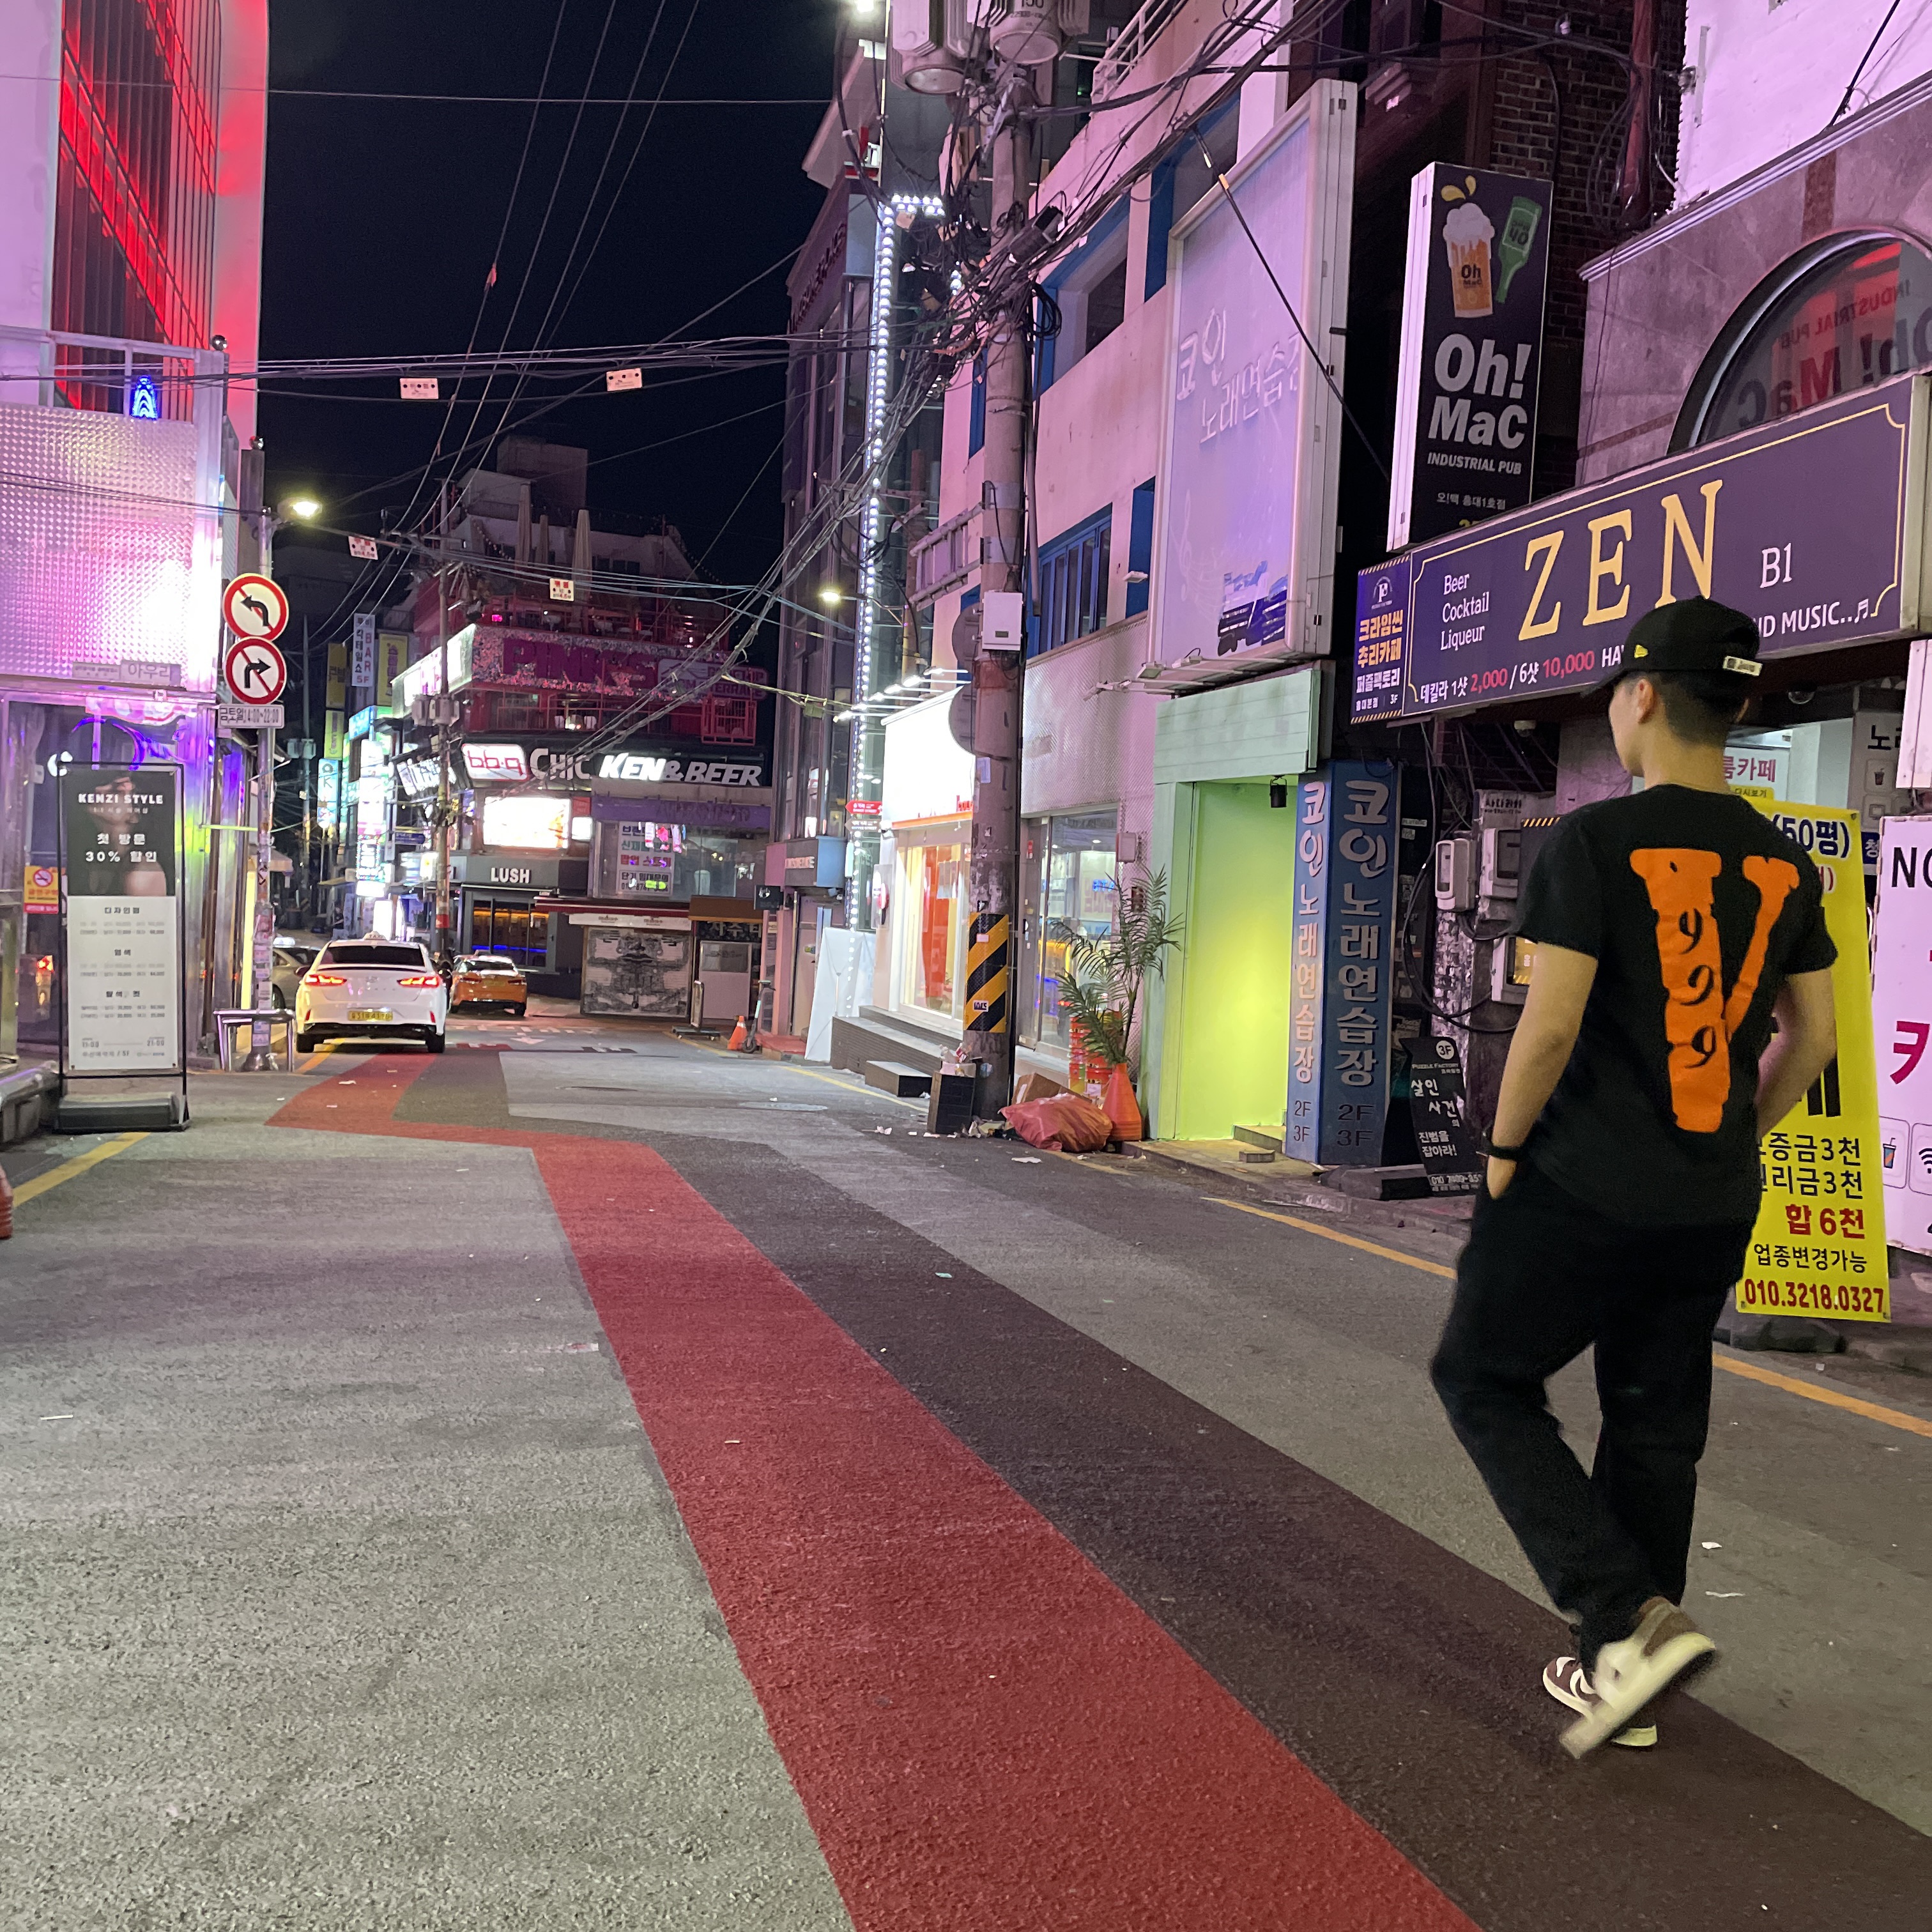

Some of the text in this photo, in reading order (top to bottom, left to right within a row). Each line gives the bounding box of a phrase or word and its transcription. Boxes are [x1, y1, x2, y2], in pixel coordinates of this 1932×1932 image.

[1461, 264, 1482, 279] Oh
[1434, 333, 1532, 399] Oh!
[1428, 395, 1528, 449] MaC
[1427, 452, 1522, 475] INDUSTRIAL PUB
[1518, 479, 1724, 641] ZEN
[1759, 542, 1792, 588] B1
[1443, 573, 1469, 595] Beer
[1441, 592, 1490, 624] Cocktail
[1358, 609, 1404, 642] 크라임씬
[1440, 625, 1485, 651] Liqueur
[1357, 637, 1402, 668] 추리카페
[1356, 667, 1400, 694] 퍼즐팩토리
[1420, 680, 1449, 705] 데킬라
[1470, 668, 1508, 694] 2,000
[1542, 650, 1595, 678] 10,000
[1601, 645, 1625, 668] HA
[78, 793, 164, 804] KENZI STYLE
[118, 833, 146, 845] 방문
[86, 850, 157, 863] 30% 할인
[491, 867, 530, 884] LUSH
[1438, 1045, 1452, 1055] 3F
[1411, 1078, 1439, 1097] 살인
[1293, 1100, 1312, 1118] 2F
[1337, 1103, 1376, 1121] 2F
[1428, 1100, 1457, 1118] 사건
[1293, 1124, 1311, 1143] 3F
[1337, 1128, 1374, 1147] 3F
[1418, 1130, 1450, 1144] 진범을
[1422, 1144, 1457, 1158] 잡아라!
[1784, 1204, 1866, 1240] 합 6천
[1754, 1243, 1867, 1274] 업종변경가능
[1744, 1278, 1885, 1314] 010.3218.0327
